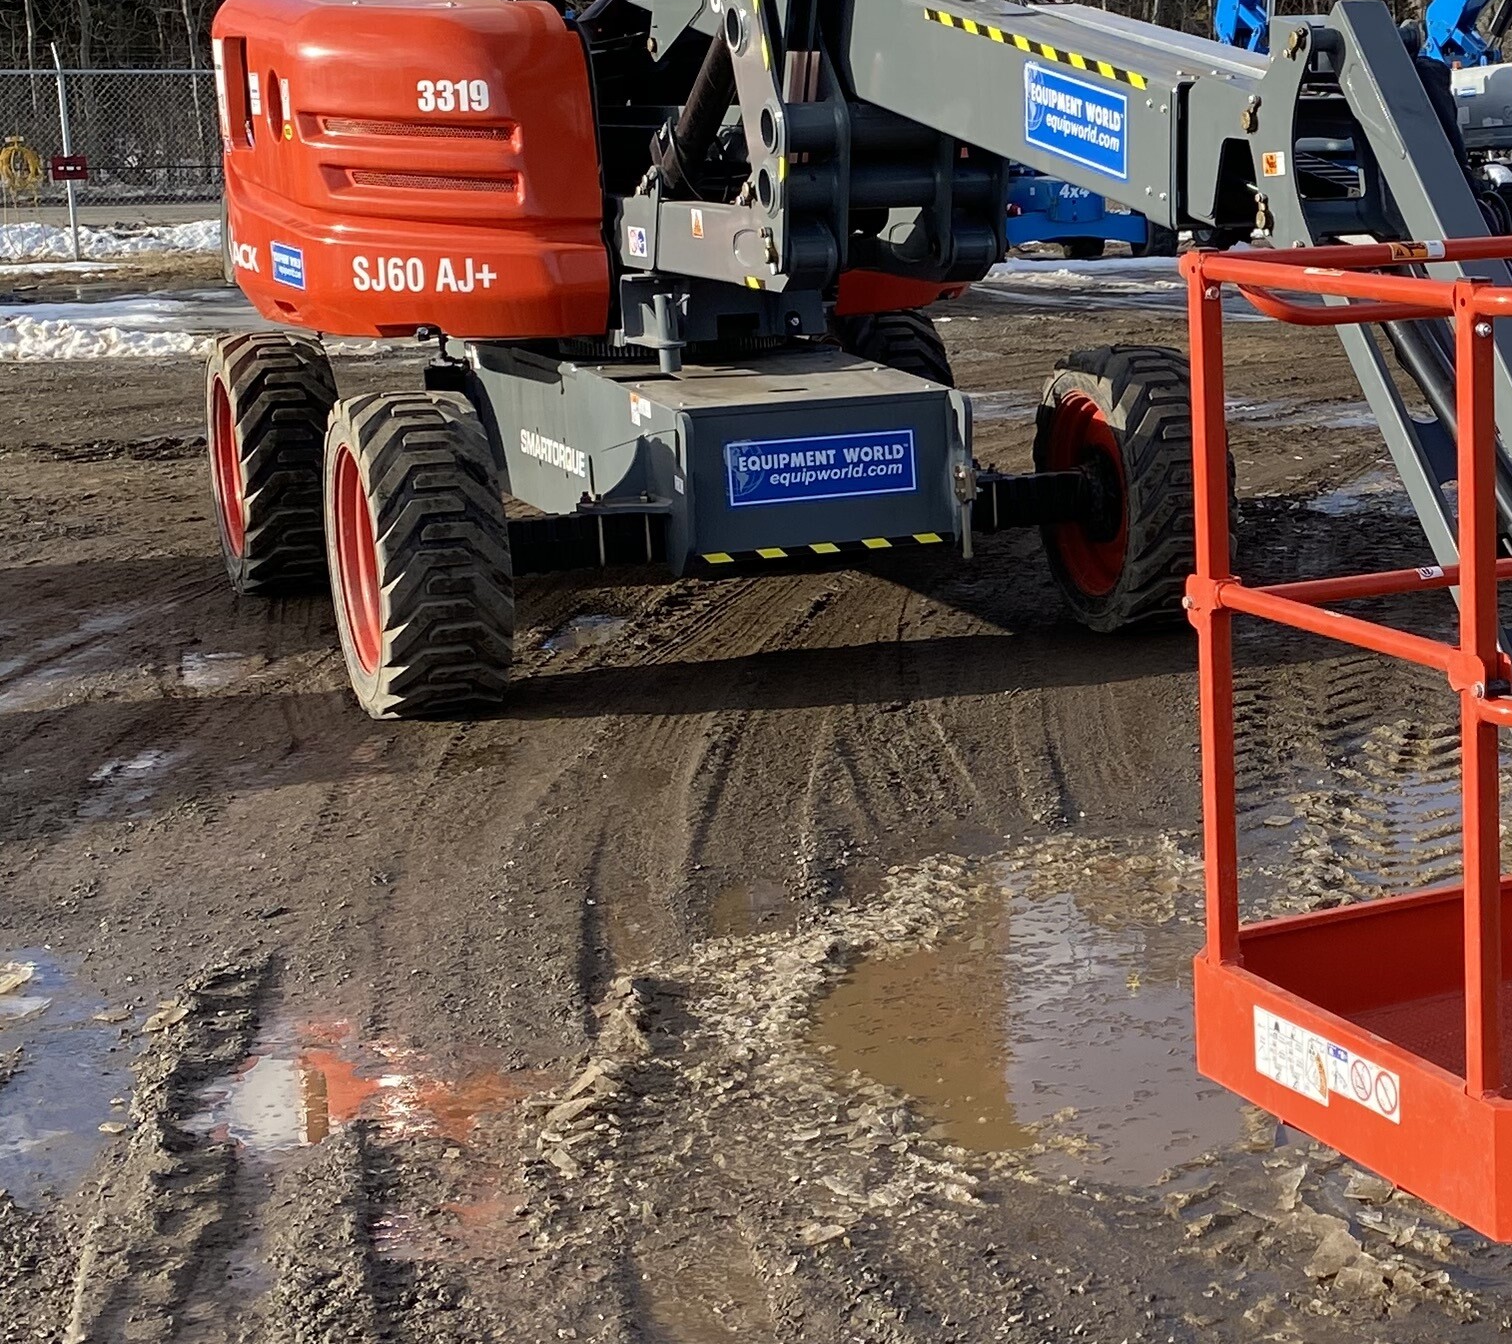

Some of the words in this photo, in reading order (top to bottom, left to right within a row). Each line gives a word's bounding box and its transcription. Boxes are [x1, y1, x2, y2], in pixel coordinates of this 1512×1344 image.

[417, 79, 490, 112] 3319
[1030, 82, 1083, 119] EQUIPMENT
[1085, 100, 1122, 132] WORLD
[1046, 113, 1120, 153] equipworld.com
[352, 255, 425, 292] SJ60
[435, 257, 498, 293] AJ+
[520, 428, 586, 478] SMARTORQUE
[738, 449, 836, 472] EQUIPMENT
[843, 444, 905, 463] WORLD
[769, 462, 903, 487] equipworld.com
